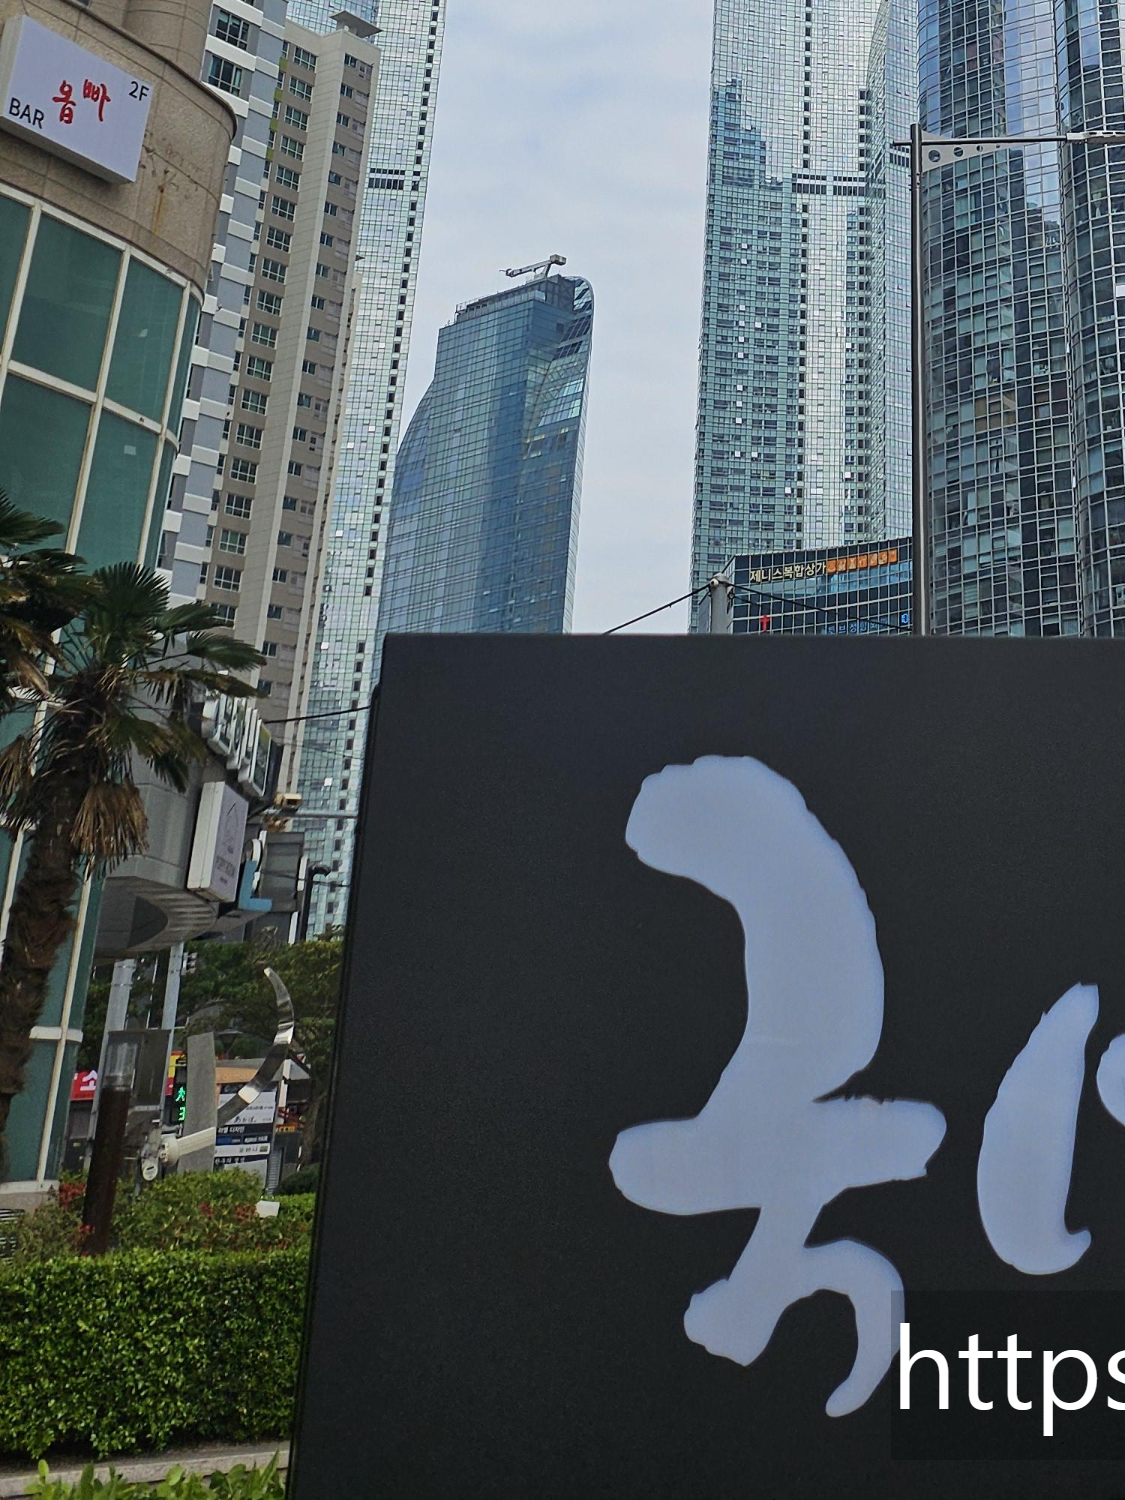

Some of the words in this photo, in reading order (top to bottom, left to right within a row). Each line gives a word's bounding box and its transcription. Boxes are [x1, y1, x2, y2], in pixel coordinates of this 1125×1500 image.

[129, 81, 149, 101] 2F
[9, 97, 45, 129] BAR
[750, 560, 827, 583] 제니스복합상가
